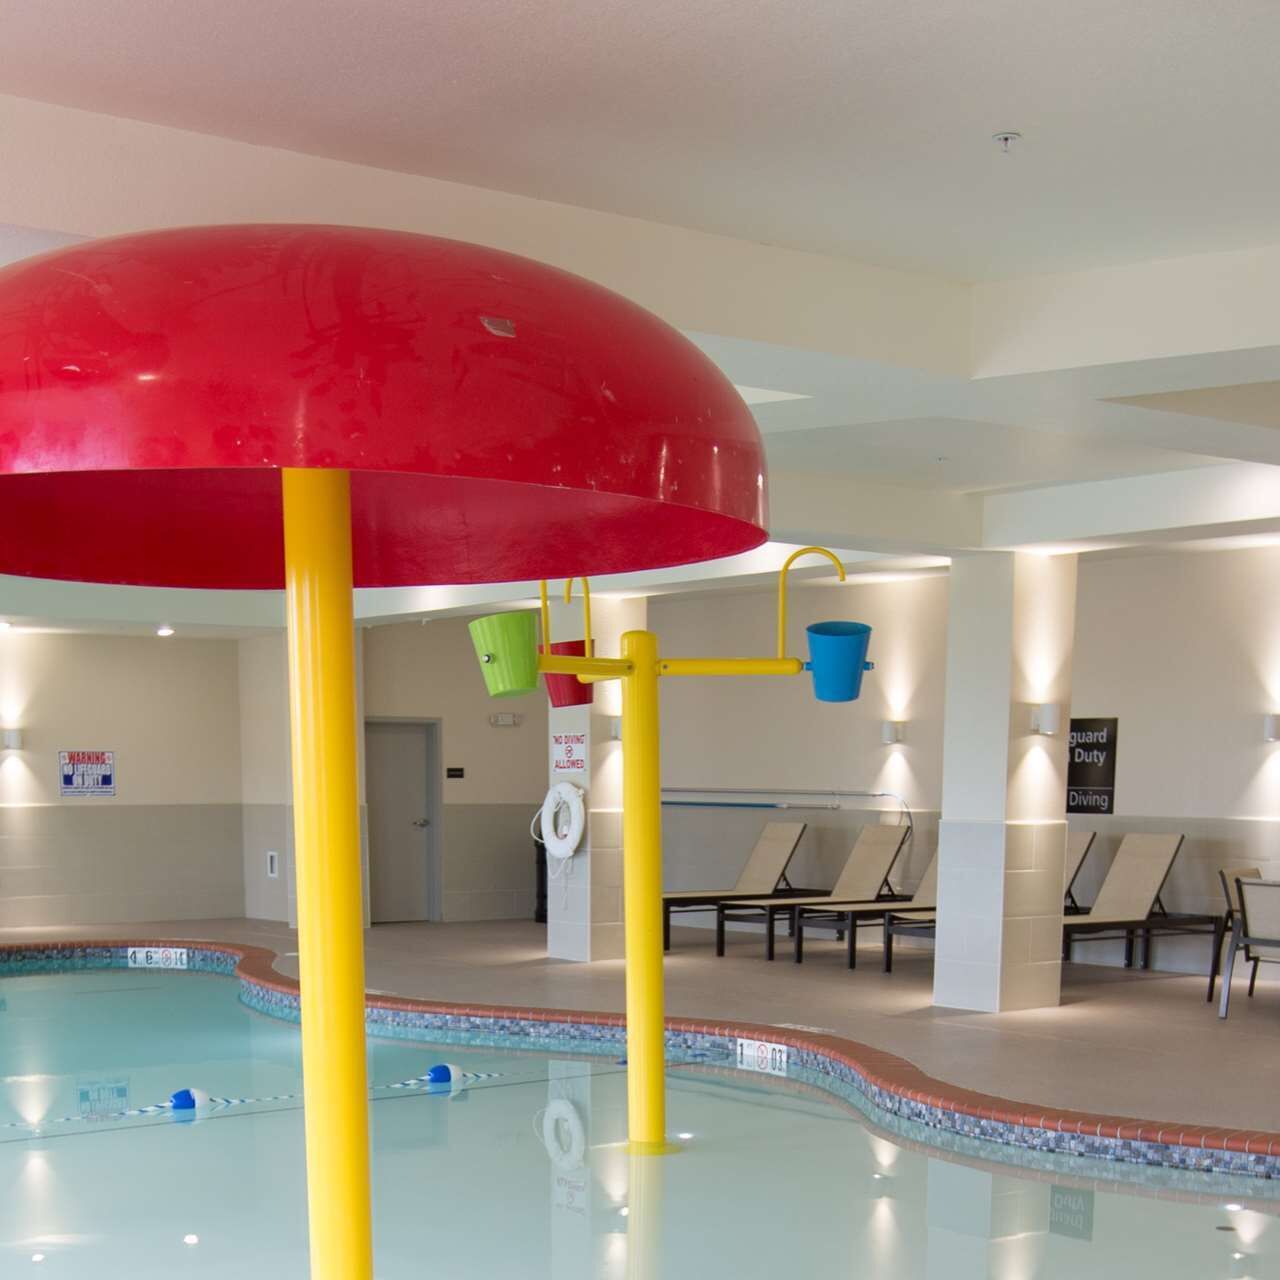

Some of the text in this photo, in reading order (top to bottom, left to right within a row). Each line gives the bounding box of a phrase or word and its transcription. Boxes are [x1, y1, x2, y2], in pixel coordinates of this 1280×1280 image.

[565, 736, 584, 744] DIVING
[67, 752, 106, 764] WARNING
[1074, 748, 1106, 767] Duty
[554, 760, 584, 768] ALLOWED
[1069, 791, 1108, 810] Diving
